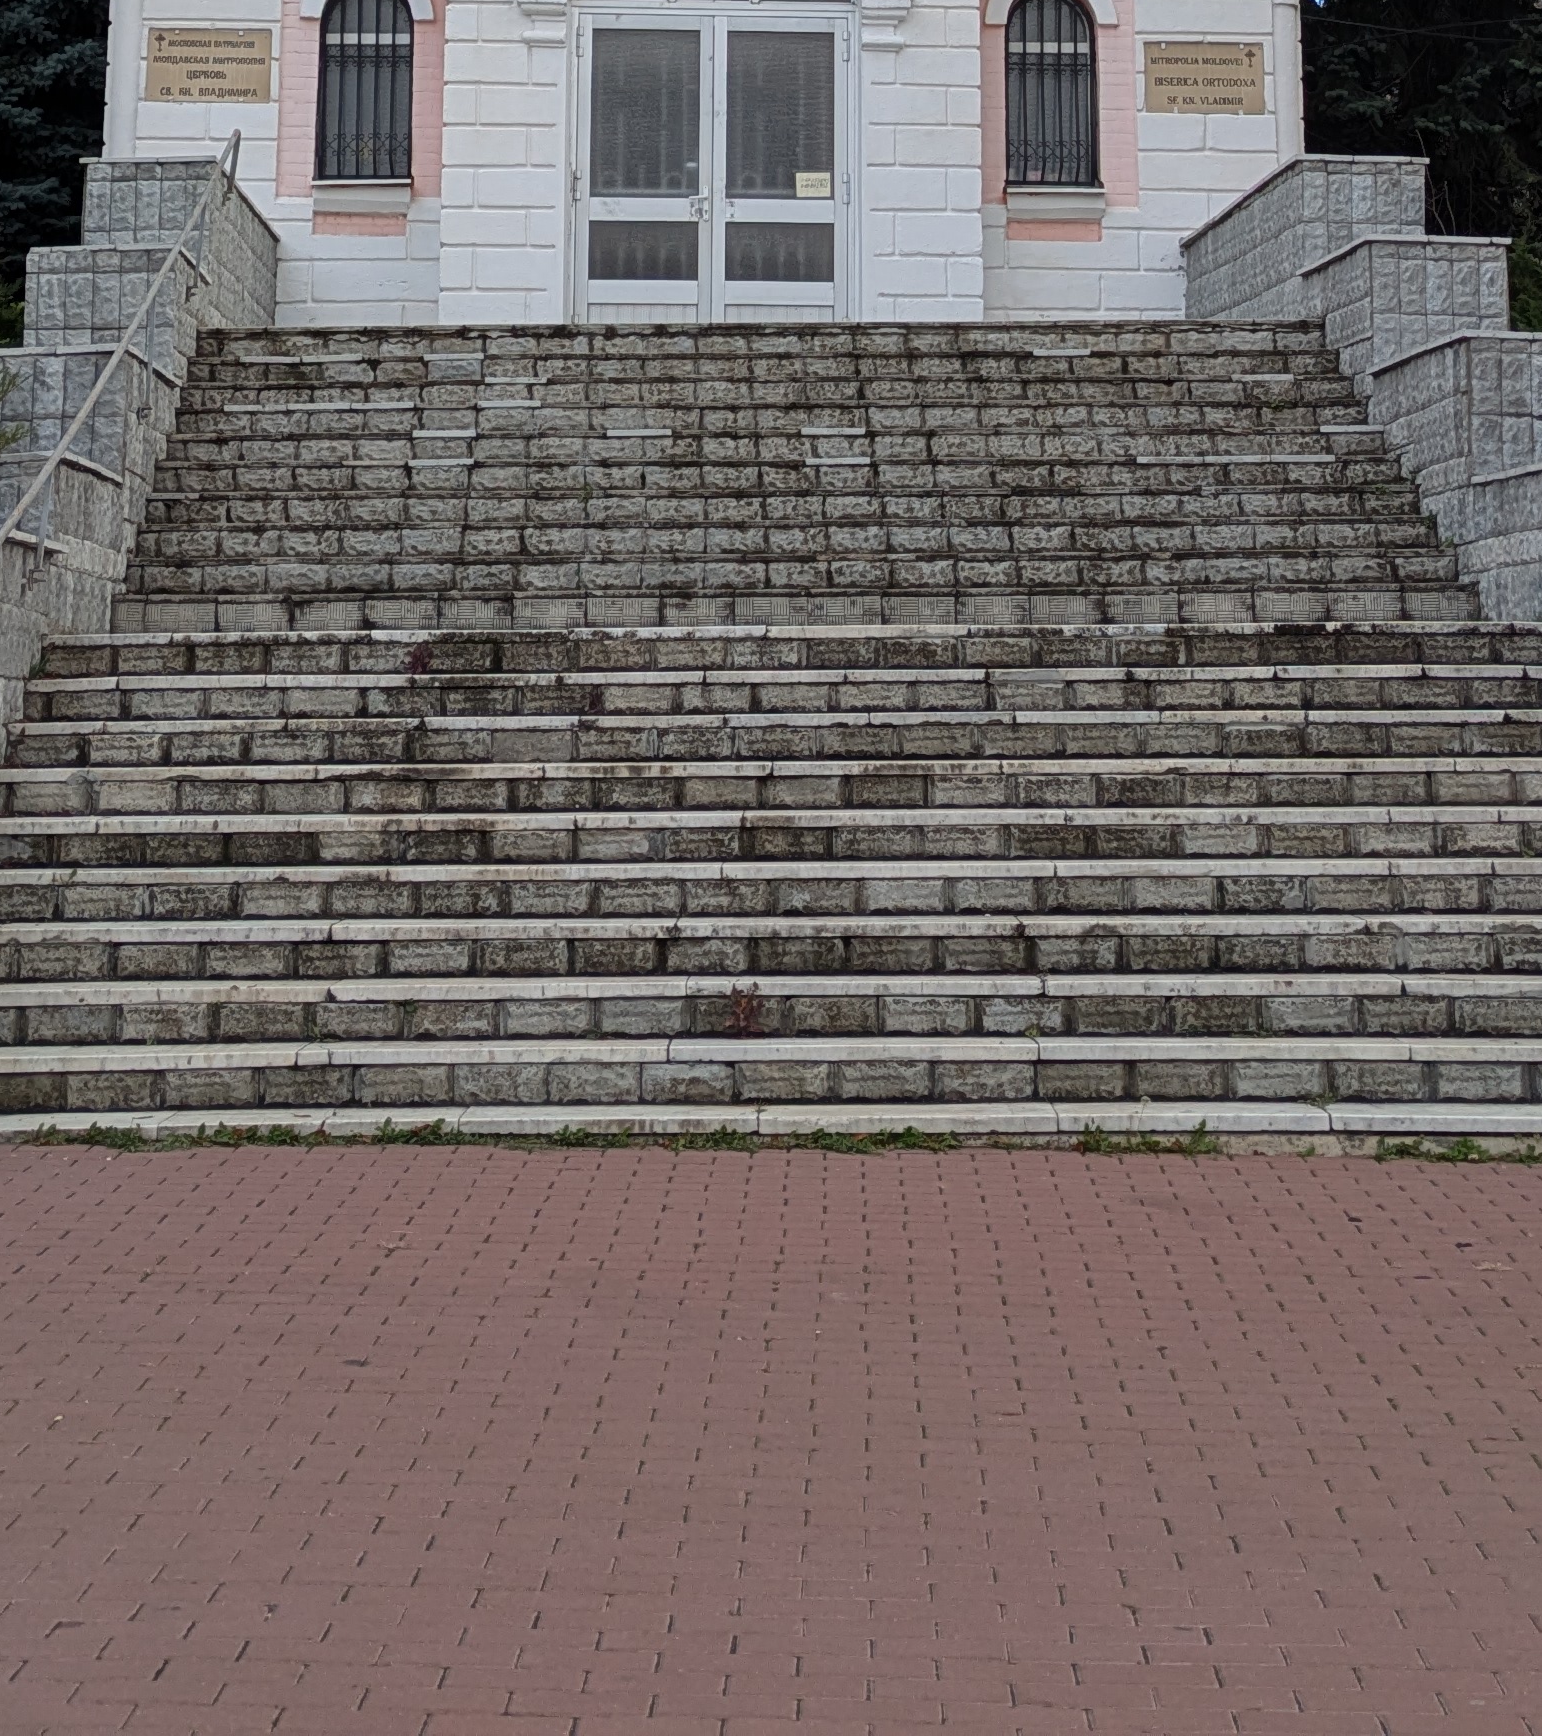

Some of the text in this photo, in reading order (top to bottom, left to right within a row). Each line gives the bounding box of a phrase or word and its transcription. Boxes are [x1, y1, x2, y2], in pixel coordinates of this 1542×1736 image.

[167, 40, 255, 49] МОСКОВСКАЯ ПАТРИАРХИЯ
[152, 56, 266, 65] МОЛДАВСКАЯ МИТРОПОЛИЯ
[1150, 57, 1244, 66] MITROPOLIA MOLDOVEI
[186, 71, 227, 81] ЦЕРКОВЬ
[1154, 77, 1256, 88] BISERICA ORTODOXA
[159, 87, 258, 98] СВ. КН. ВЛАДИМИРА
[1199, 97, 1244, 106] VLADIMIR
